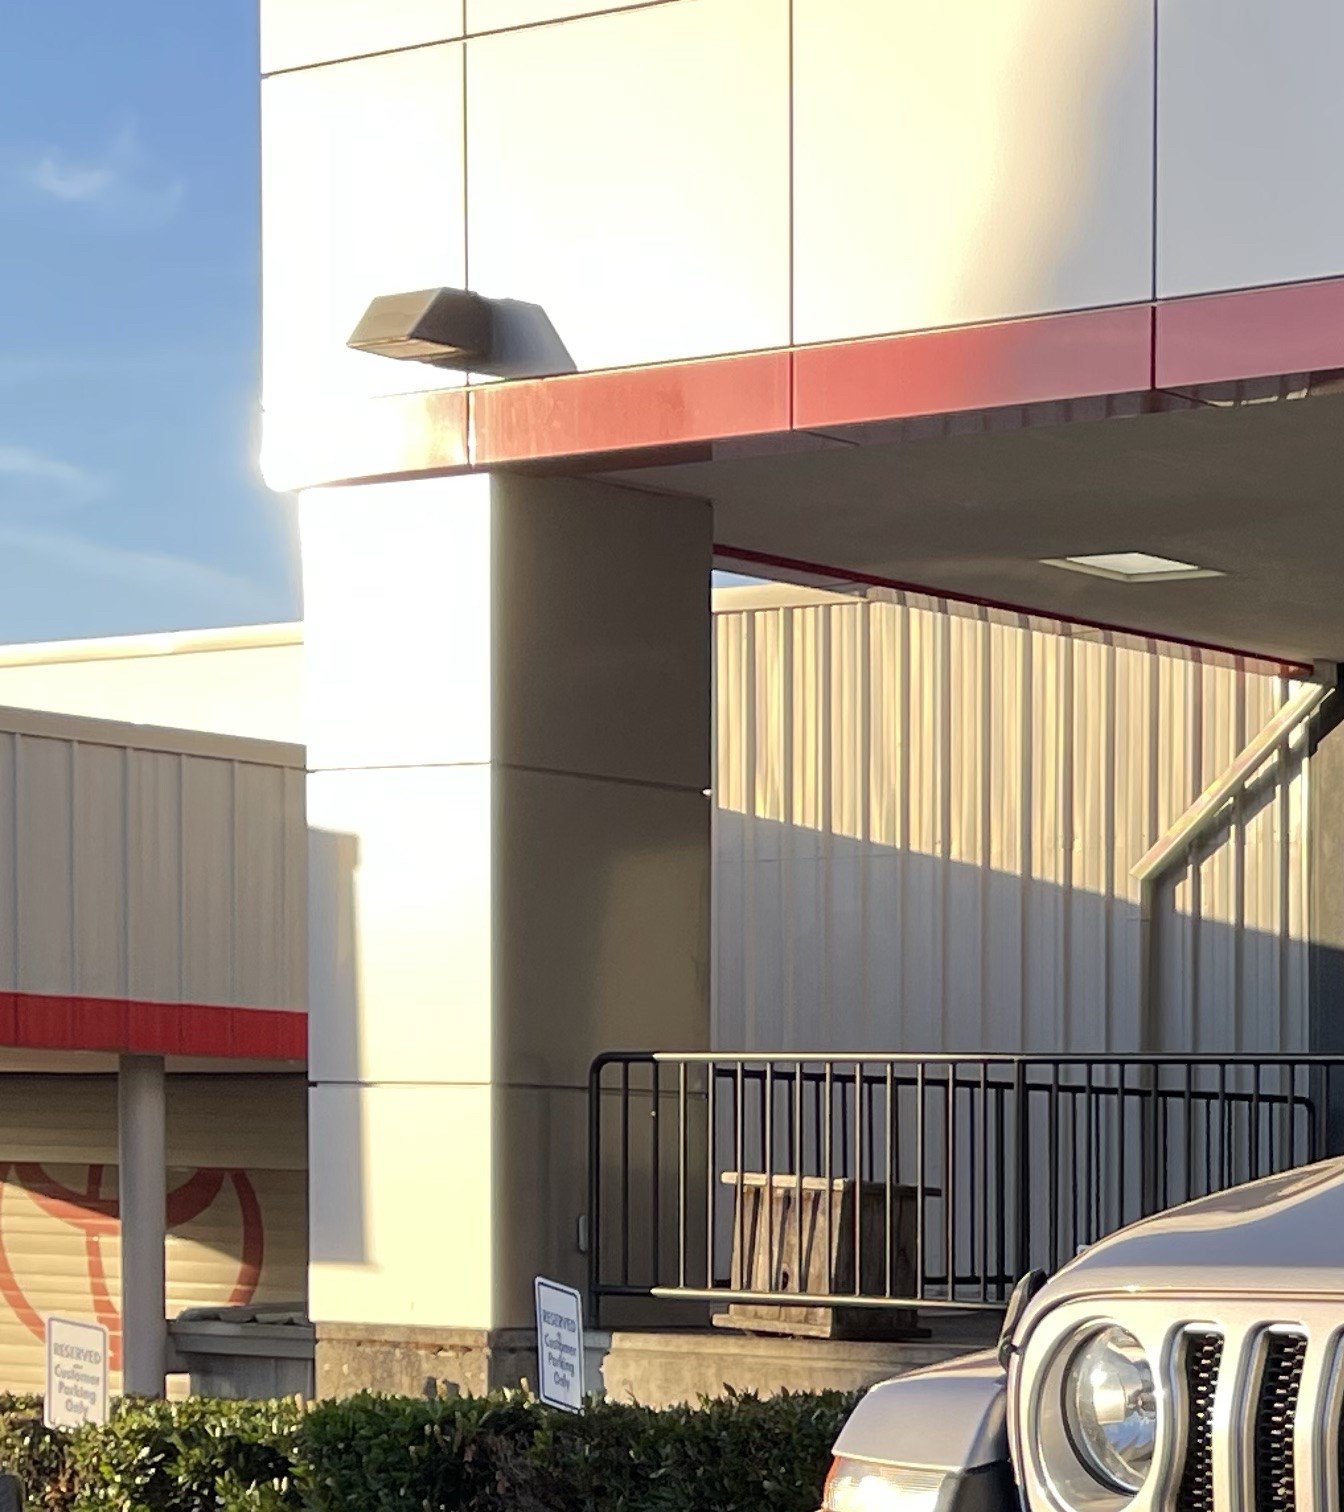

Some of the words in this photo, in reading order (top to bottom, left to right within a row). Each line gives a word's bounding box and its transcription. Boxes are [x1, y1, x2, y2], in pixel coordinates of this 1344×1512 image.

[53, 1341, 101, 1364] RESERVED
[54, 1364, 100, 1386] Customer
[57, 1381, 96, 1404] Parking
[65, 1399, 89, 1418] Only
